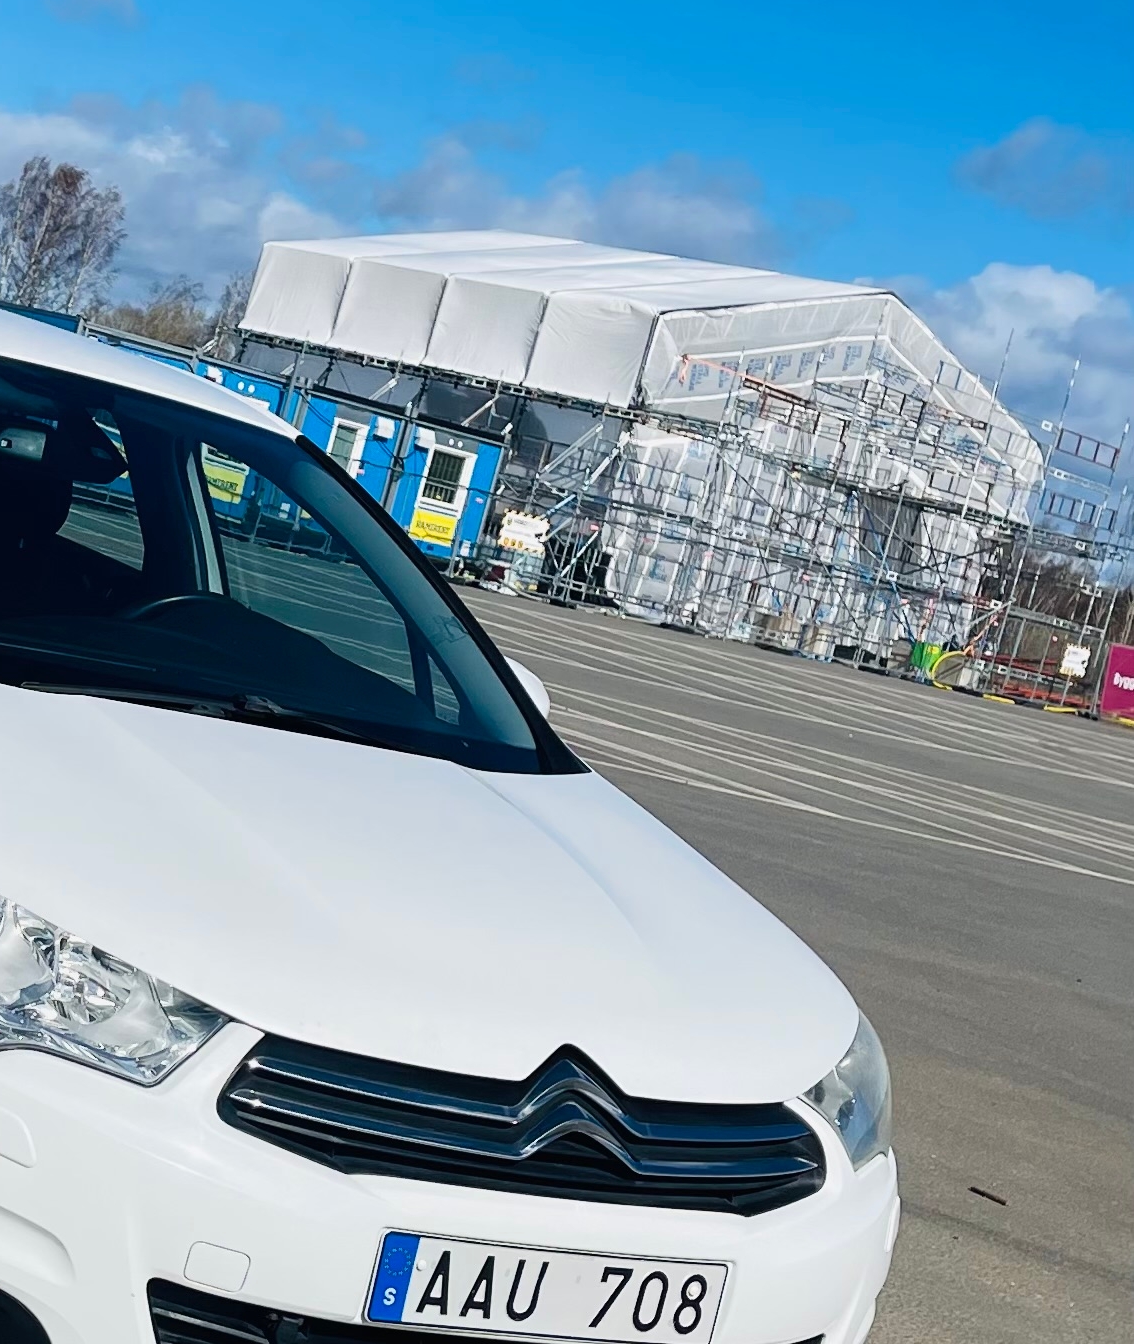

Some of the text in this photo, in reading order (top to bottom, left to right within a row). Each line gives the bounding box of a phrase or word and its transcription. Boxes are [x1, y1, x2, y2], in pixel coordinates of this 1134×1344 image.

[383, 1287, 397, 1306] S
[415, 1250, 708, 1335] AAU 708
